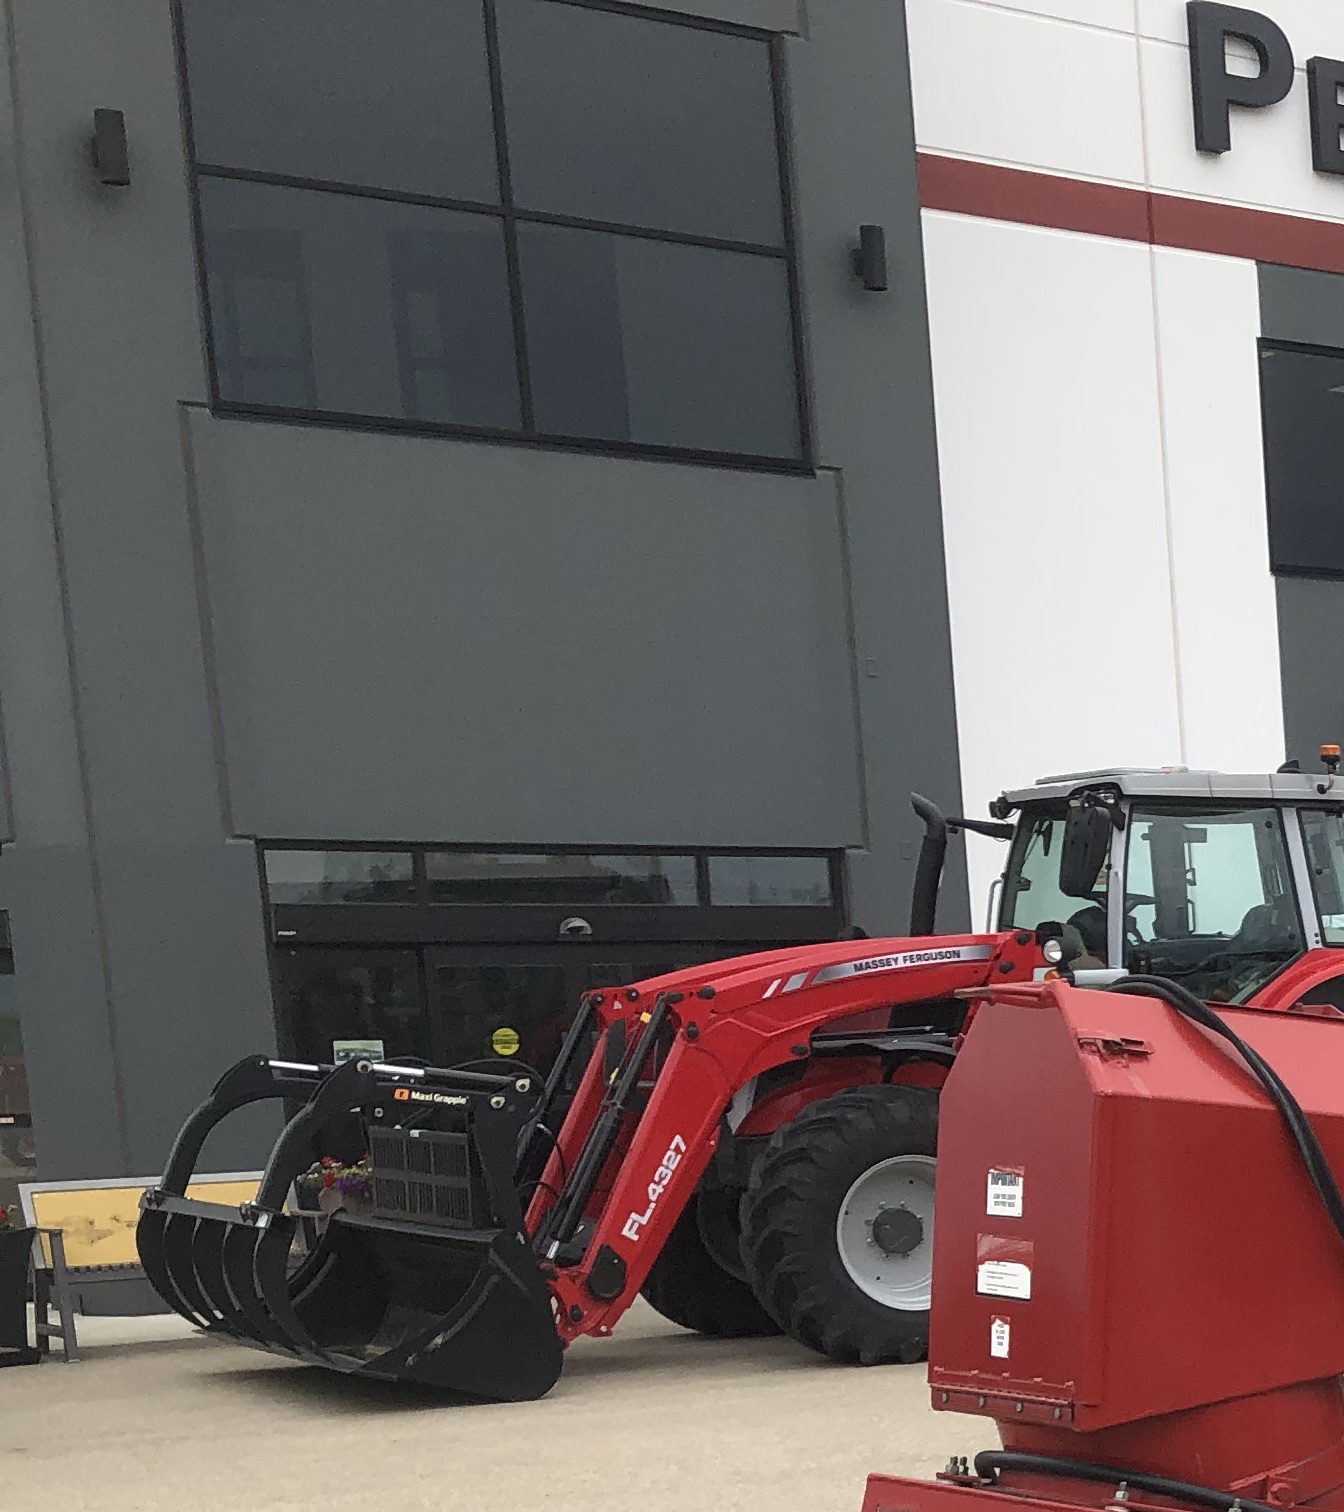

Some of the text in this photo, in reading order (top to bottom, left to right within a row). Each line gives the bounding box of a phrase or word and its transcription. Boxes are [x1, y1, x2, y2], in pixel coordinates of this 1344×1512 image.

[853, 949, 961, 972] MASSEY FERGUSON
[411, 1091, 468, 1105] Maxi Grapple
[621, 1134, 687, 1242] FL.4327
